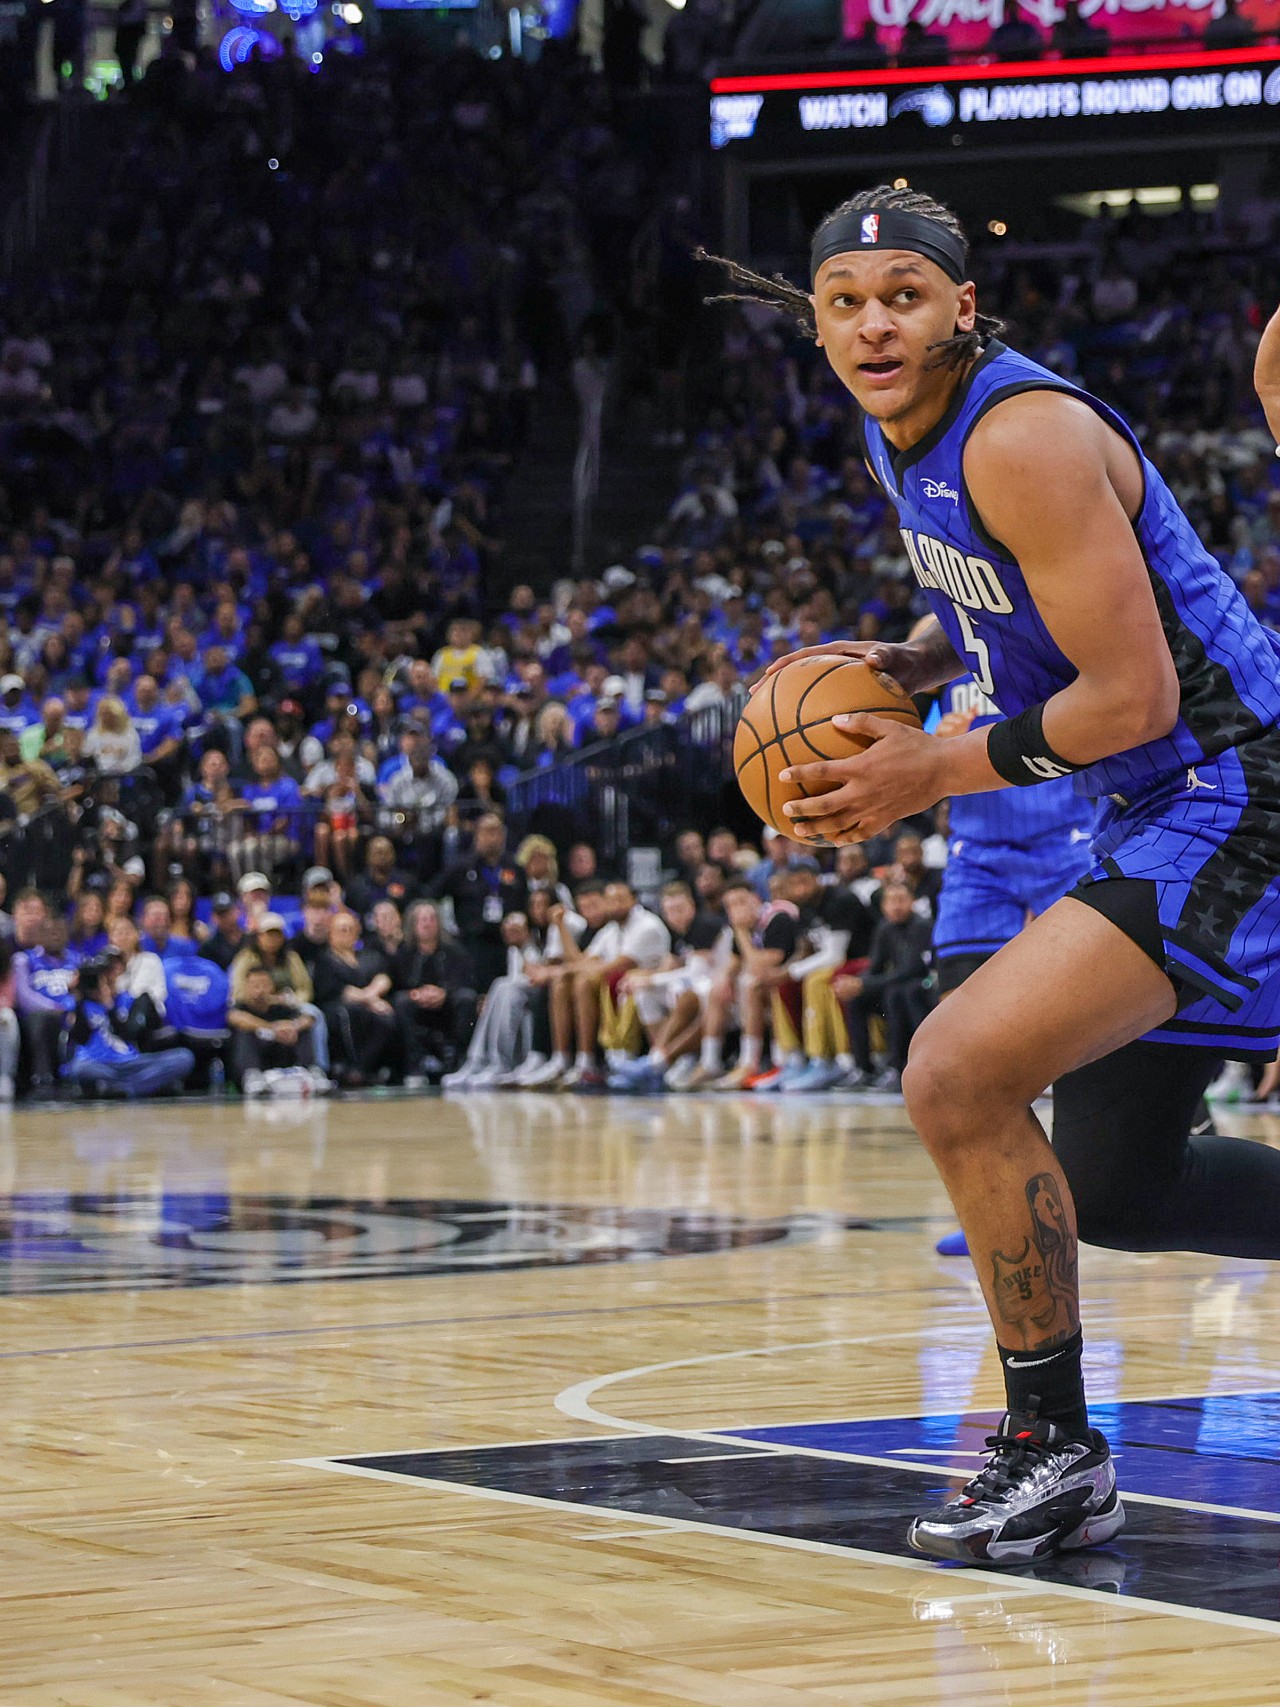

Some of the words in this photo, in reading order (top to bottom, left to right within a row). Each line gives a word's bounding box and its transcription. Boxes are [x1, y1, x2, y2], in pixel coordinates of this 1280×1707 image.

[799, 92, 888, 131] WATCH
[959, 81, 1080, 122] PLAYOFFS
[1081, 77, 1170, 116] ROUND
[1171, 73, 1224, 111] ONE
[1224, 70, 1262, 106] ON
[899, 528, 1014, 615] RLANDO
[951, 601, 995, 695] 5
[1003, 1265, 1042, 1288] DUKE
[1018, 1281, 1032, 1299] 5
